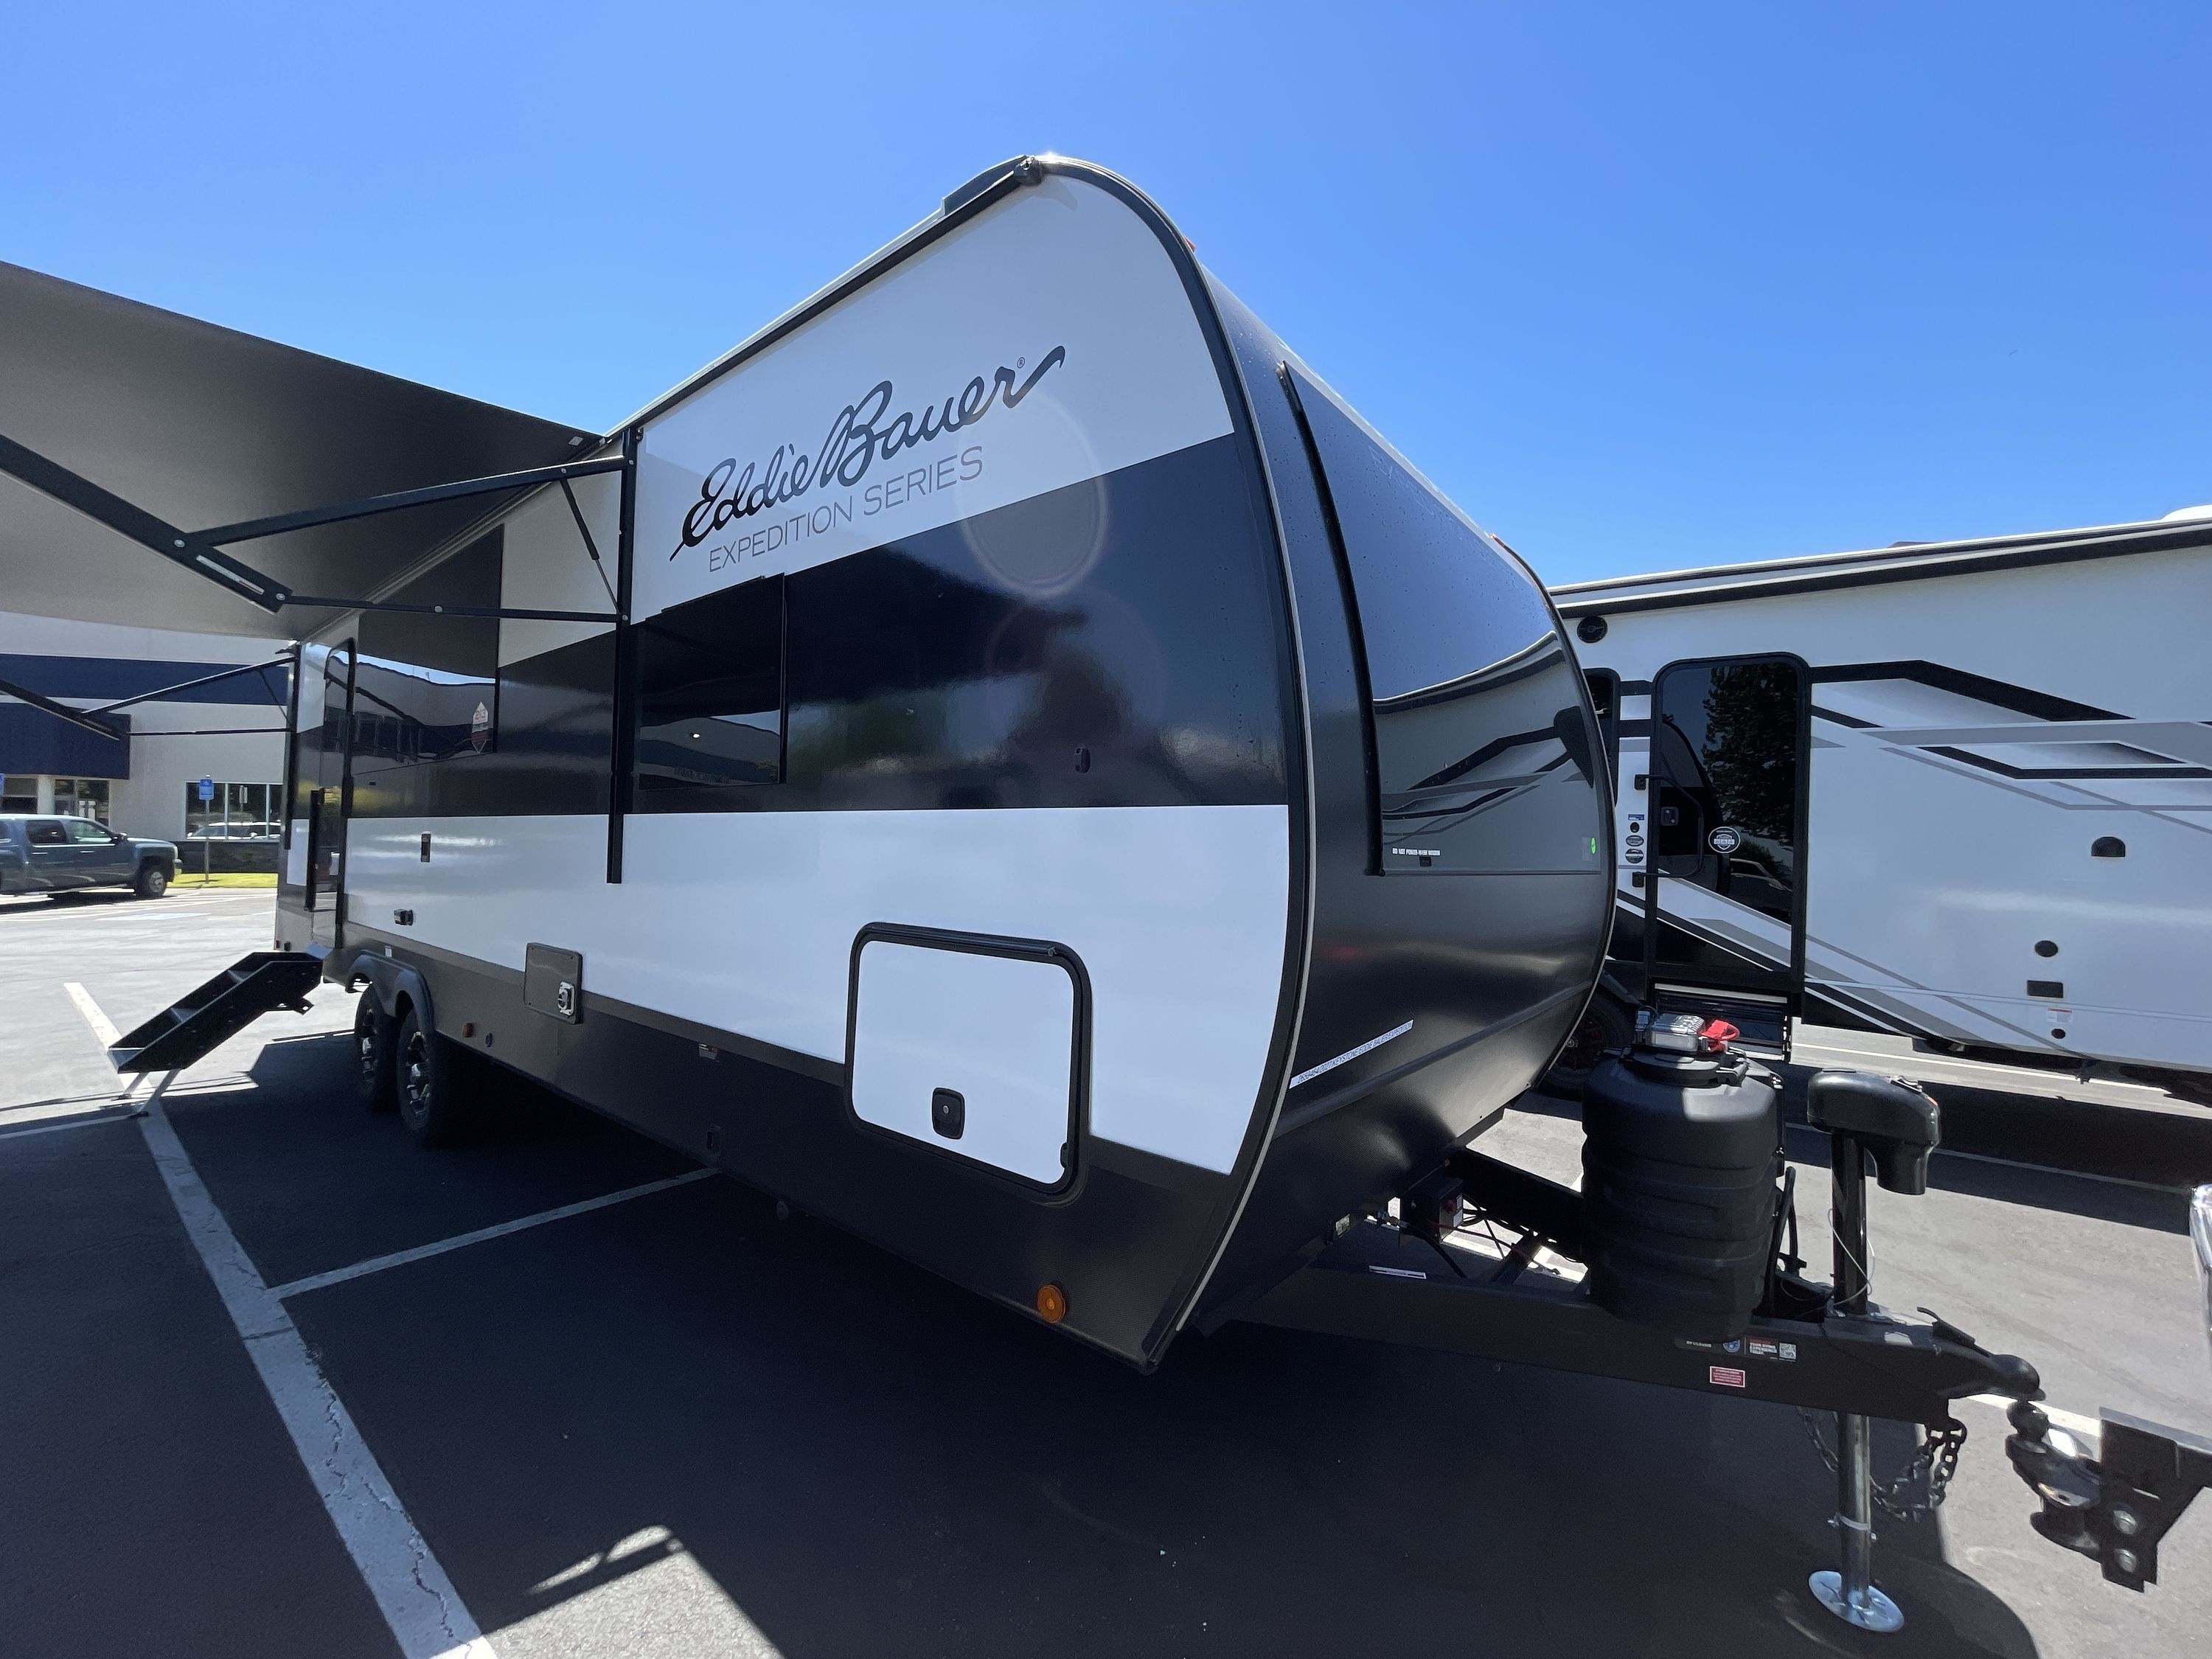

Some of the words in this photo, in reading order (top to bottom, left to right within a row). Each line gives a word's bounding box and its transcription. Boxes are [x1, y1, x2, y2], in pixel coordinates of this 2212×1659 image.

[669, 444, 820, 562] Eddie
[709, 495, 853, 573] EXPEDITION
[863, 445, 984, 516] SERIES
